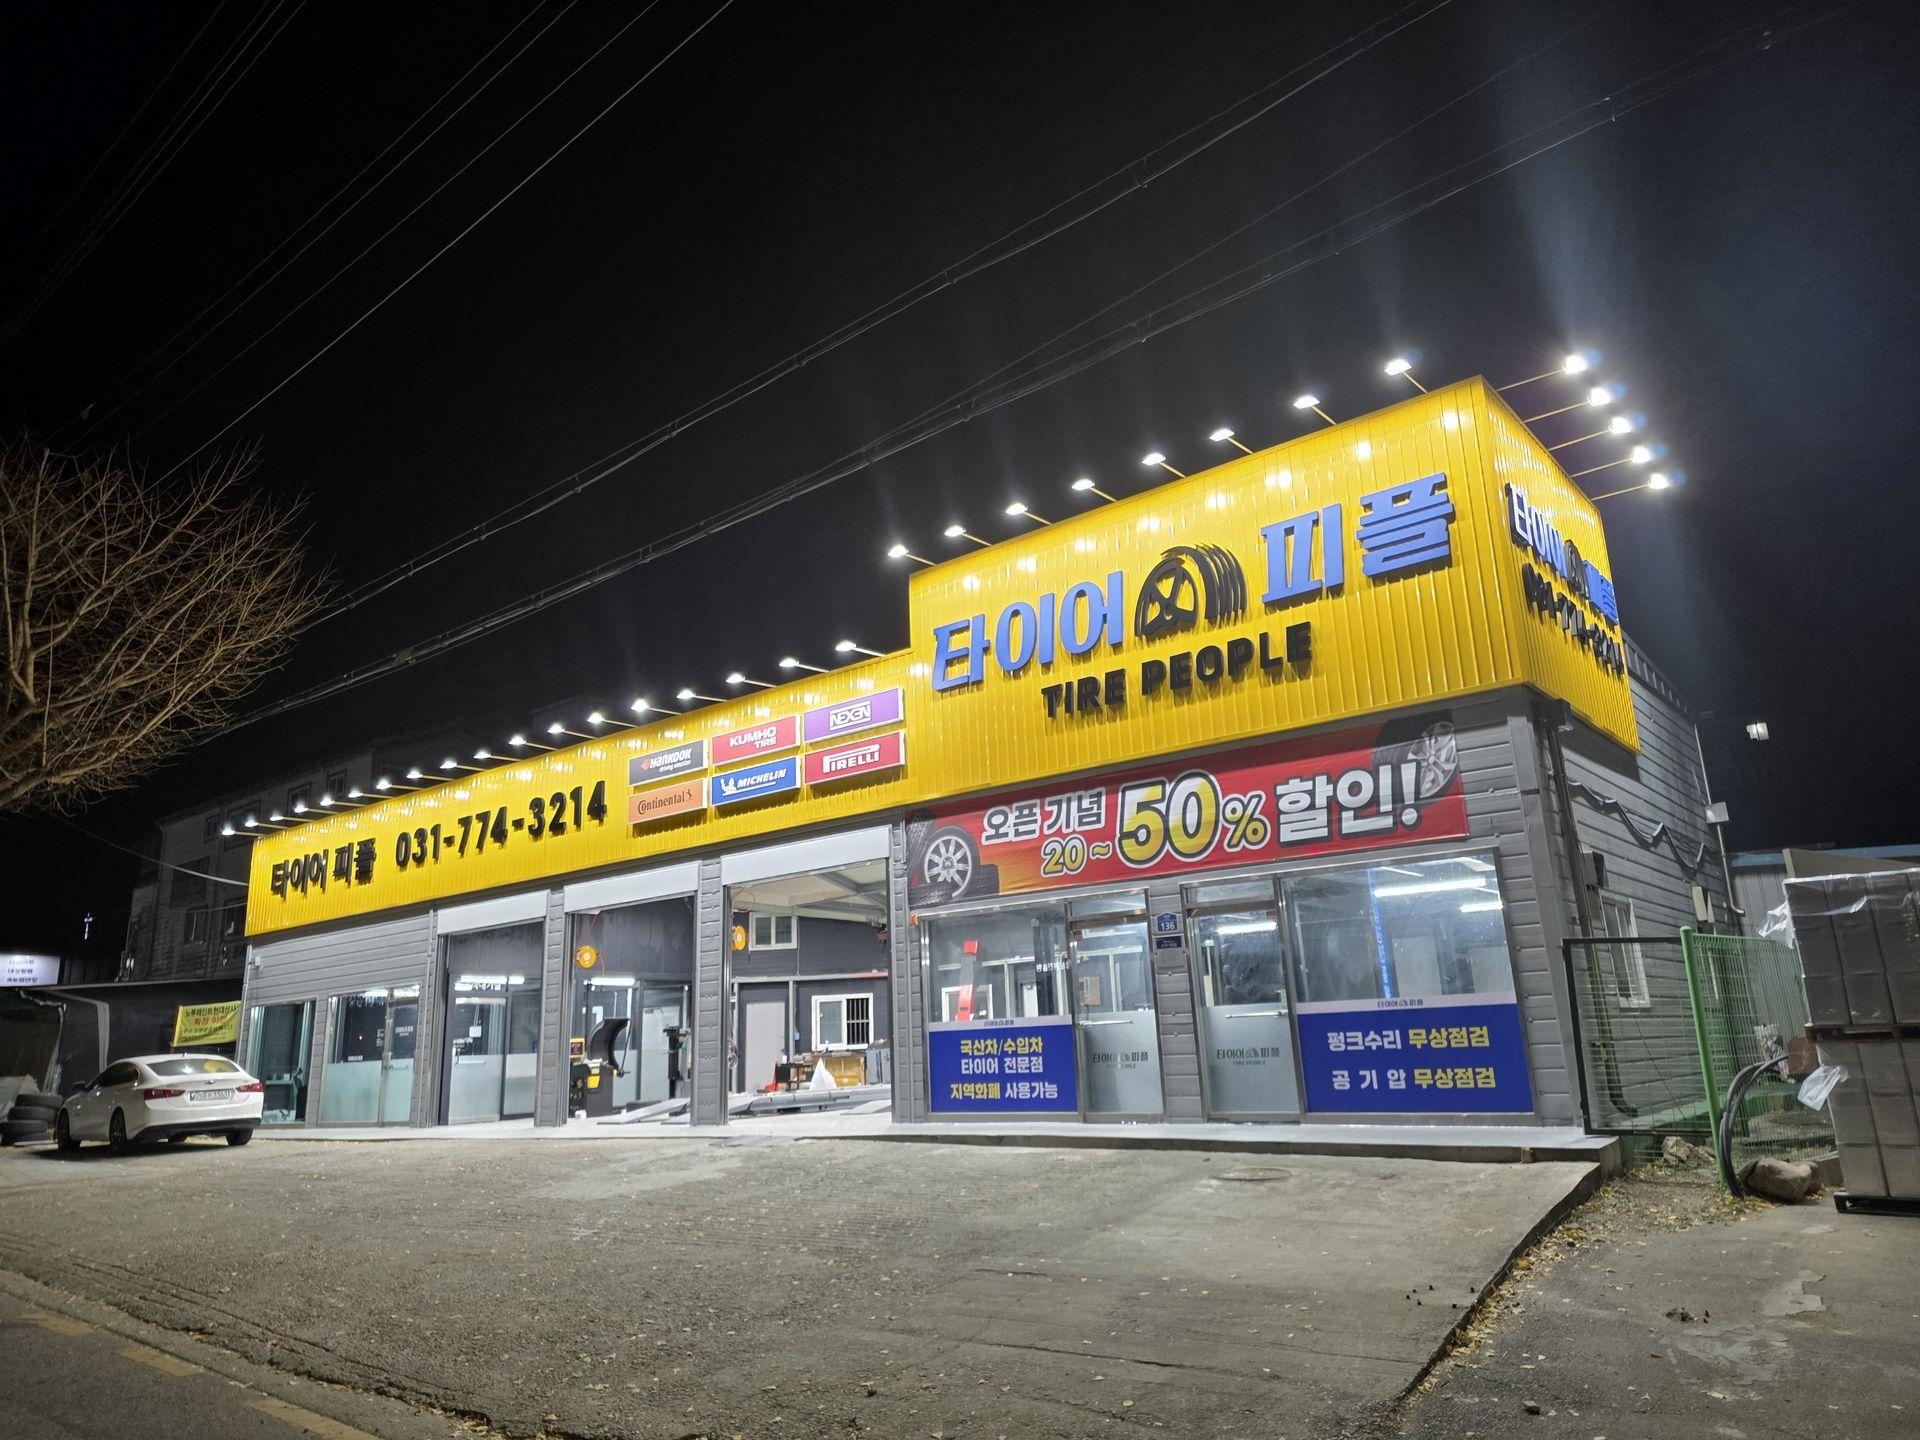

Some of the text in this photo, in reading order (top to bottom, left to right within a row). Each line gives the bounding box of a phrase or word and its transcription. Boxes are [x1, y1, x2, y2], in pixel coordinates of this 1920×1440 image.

[931, 471, 1455, 691] 타이어 피플
[1041, 621, 1312, 719] TIRE PEOPLE
[829, 702, 871, 729] NEXEN
[729, 726, 777, 747] KUMHO
[754, 737, 777, 749] TIRE
[822, 744, 880, 773] PIRELLI
[737, 768, 787, 788] MICHELIN
[637, 790, 685, 814] Continental
[1276, 761, 1421, 845] 할인!
[395, 781, 606, 870] 031-774-3214
[982, 788, 1106, 846] 오픈 기념
[271, 837, 377, 897] 타이어 피플
[1161, 921, 1175, 930] 136
[961, 1037, 1043, 1056] 국산차/수입차
[1327, 1026, 1490, 1051] 펑크수리 무상점검
[961, 1056, 1044, 1074] 타이어 전문점
[1413, 1067, 1496, 1089] 무상점검
[951, 1082, 1058, 1099] 지역화폐 사용가능
